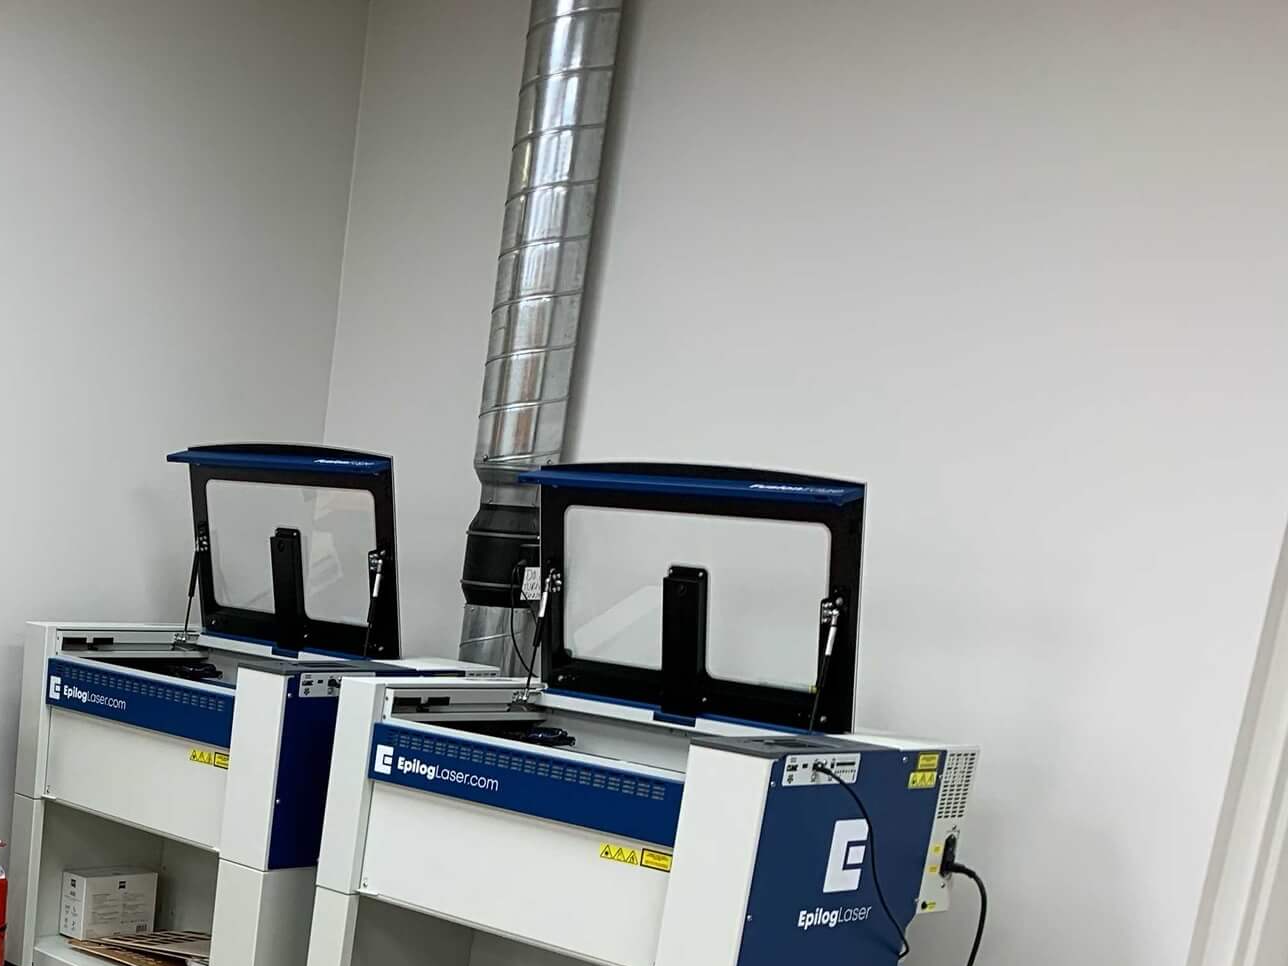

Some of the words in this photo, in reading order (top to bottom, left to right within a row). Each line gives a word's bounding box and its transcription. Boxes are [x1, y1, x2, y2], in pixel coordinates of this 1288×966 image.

[63, 685, 127, 711] EpilogLaser.com
[397, 756, 499, 791] EpilogLaser.com
[797, 905, 873, 930] EpilogLaser
